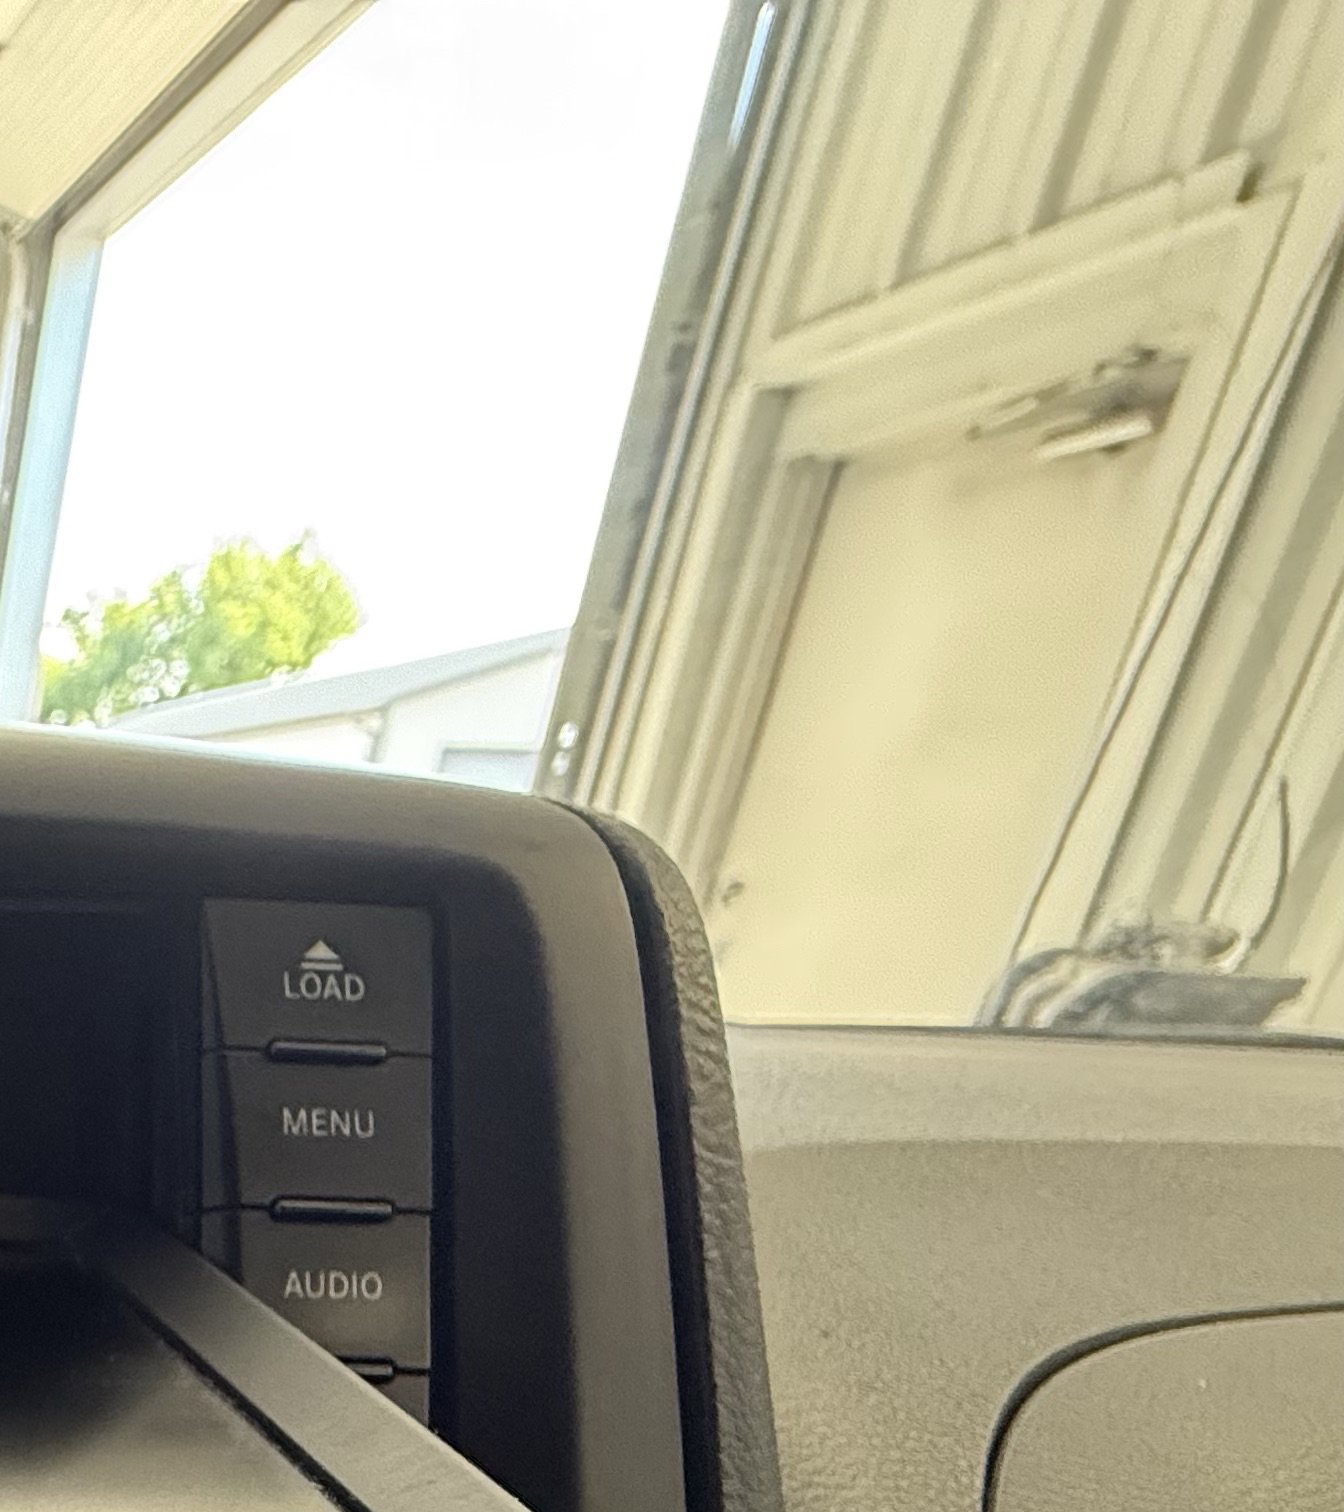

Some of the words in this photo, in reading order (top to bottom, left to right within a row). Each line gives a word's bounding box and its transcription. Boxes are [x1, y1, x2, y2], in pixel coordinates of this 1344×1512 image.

[283, 971, 365, 1001] LOAD
[282, 1107, 375, 1138] MENU
[283, 1271, 383, 1301] AUDIO
